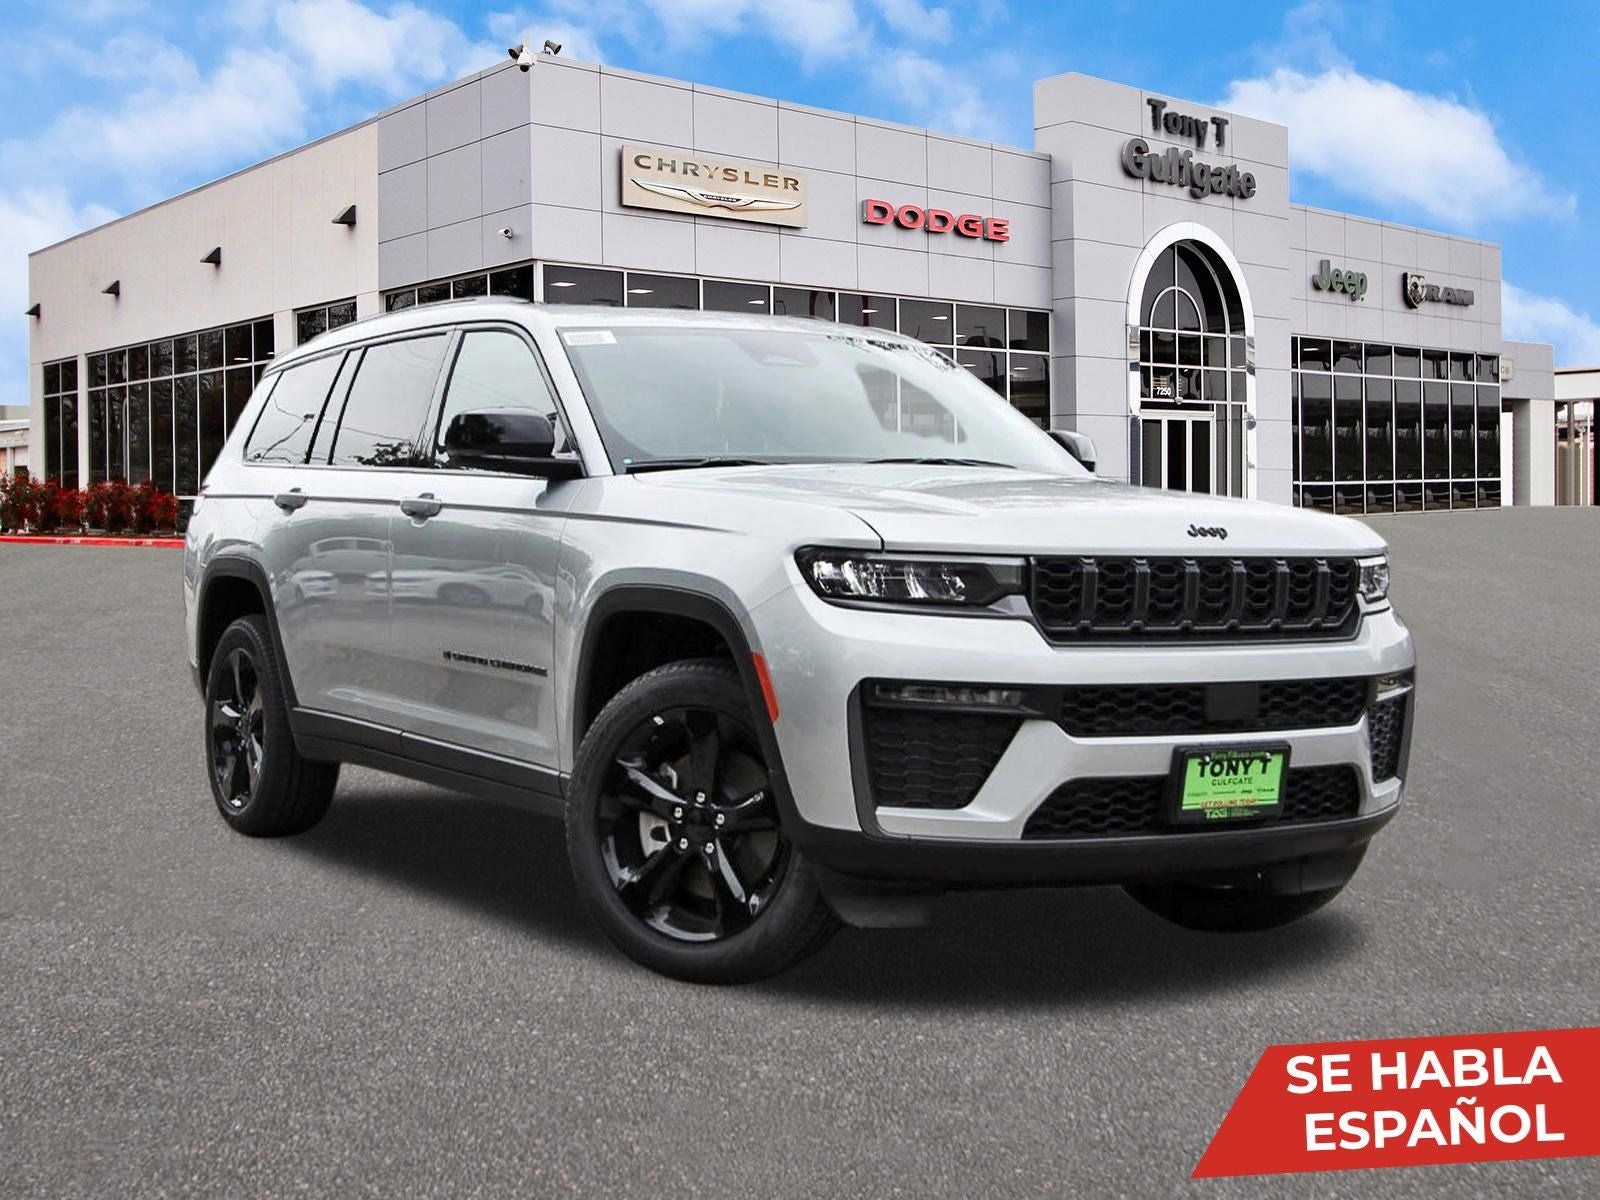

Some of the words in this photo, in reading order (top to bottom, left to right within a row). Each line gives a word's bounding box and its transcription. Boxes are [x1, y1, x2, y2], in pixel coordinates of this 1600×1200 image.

[1147, 98, 1208, 148] Tony
[1211, 116, 1229, 147] T
[633, 154, 800, 192] CHRYSLER
[1121, 138, 1257, 199] Gulfgate
[862, 198, 1011, 243] DODGE
[1312, 259, 1368, 301] Jeep
[1424, 284, 1475, 306] RAM
[1187, 524, 1228, 540] Jeep
[1198, 759, 1253, 778] TONY
[1259, 757, 1272, 775] T
